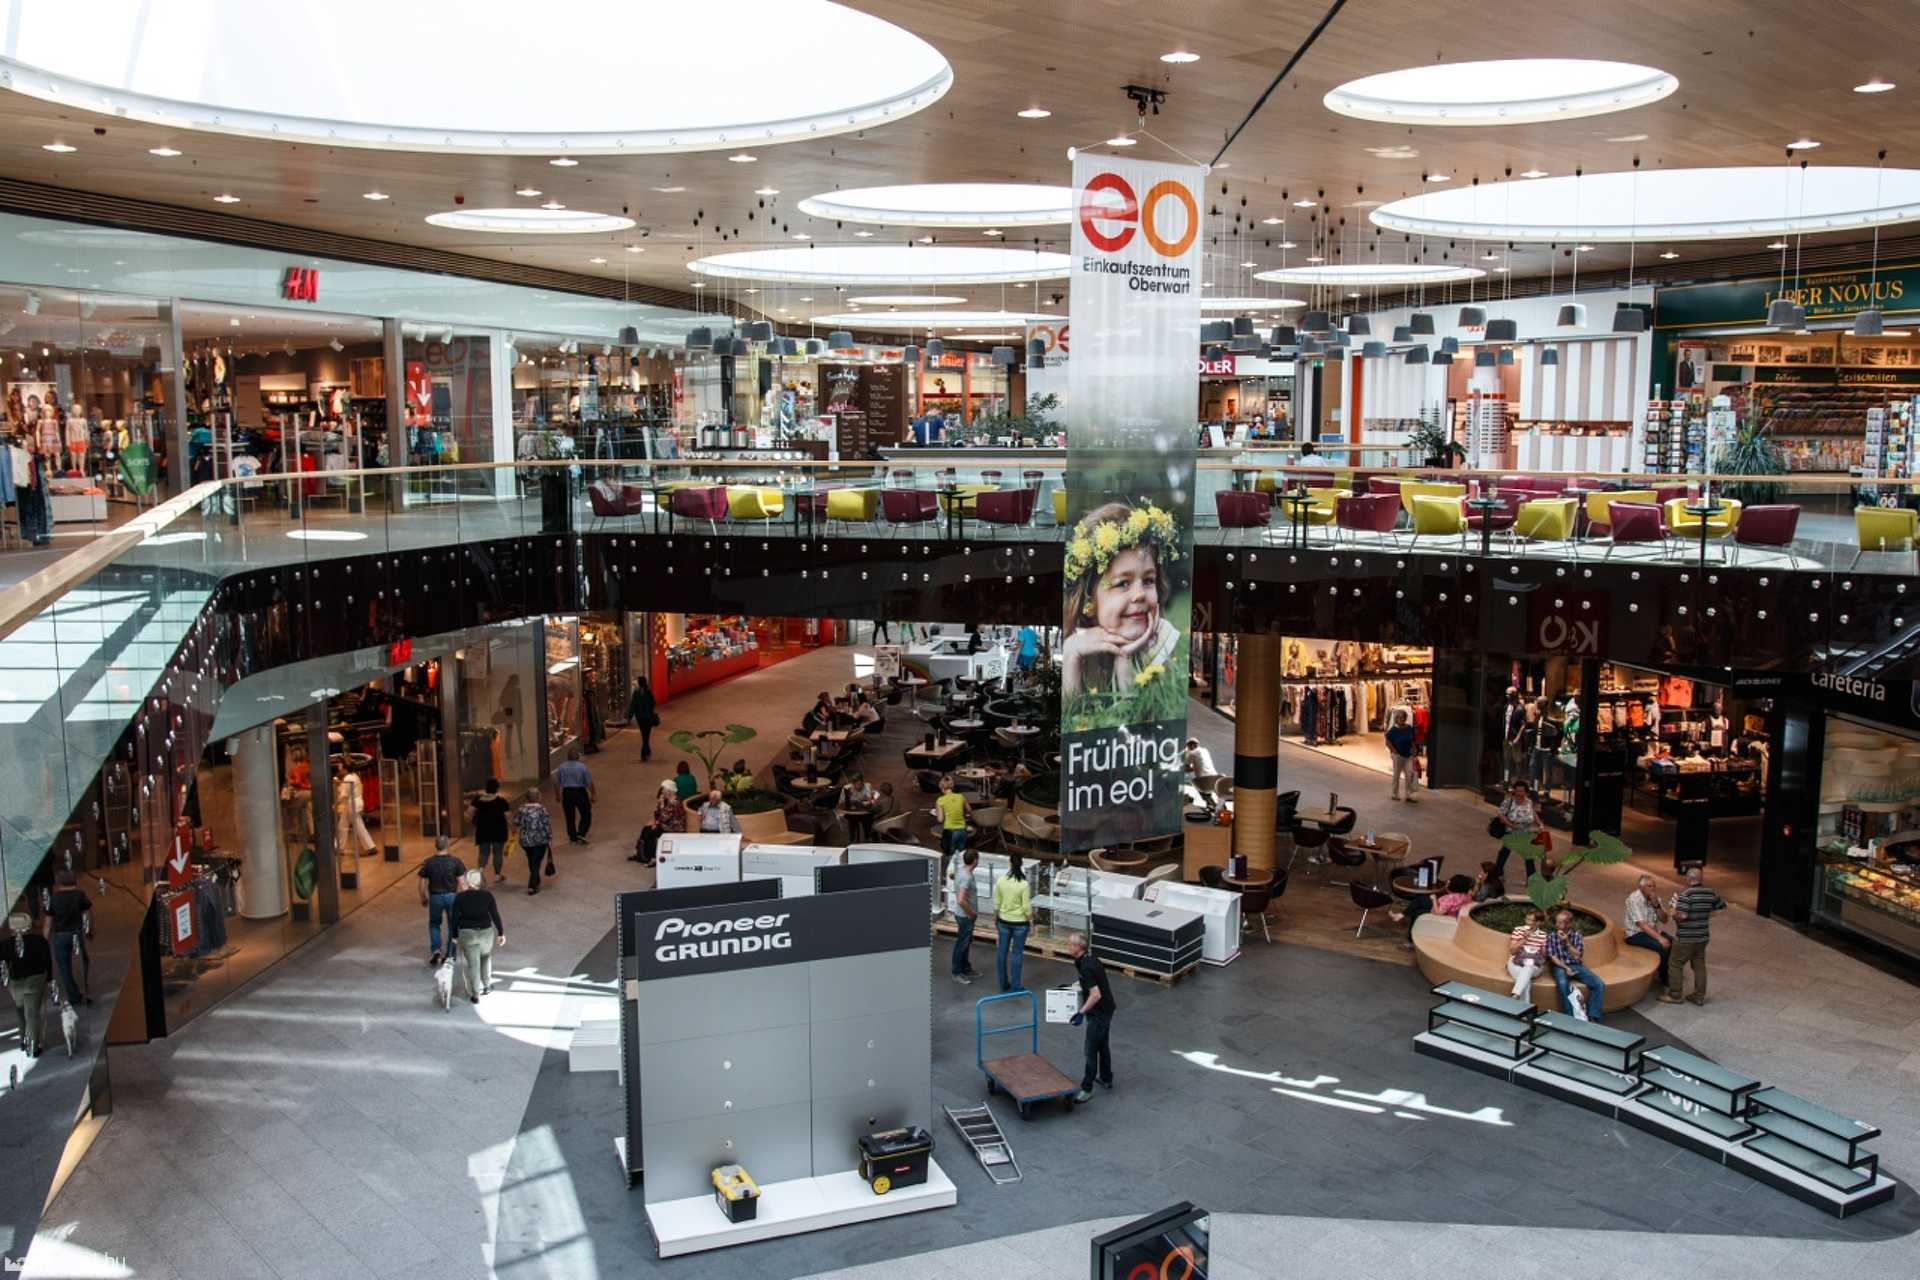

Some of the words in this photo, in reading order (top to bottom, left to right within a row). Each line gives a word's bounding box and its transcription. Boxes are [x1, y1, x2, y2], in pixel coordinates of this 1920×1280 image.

[1080, 172, 1199, 257] eo
[1083, 256, 1190, 279] Einkaufszentrum
[285, 266, 319, 302] H&M
[1128, 276, 1190, 294] Oberwart
[1828, 280, 1905, 305] NOVUS
[1068, 735, 1179, 775] Frühling
[1068, 780, 1103, 812] im
[1110, 768, 1153, 804] eo!
[654, 913, 791, 941] Pioneer
[655, 932, 792, 963] GRUNDIG
